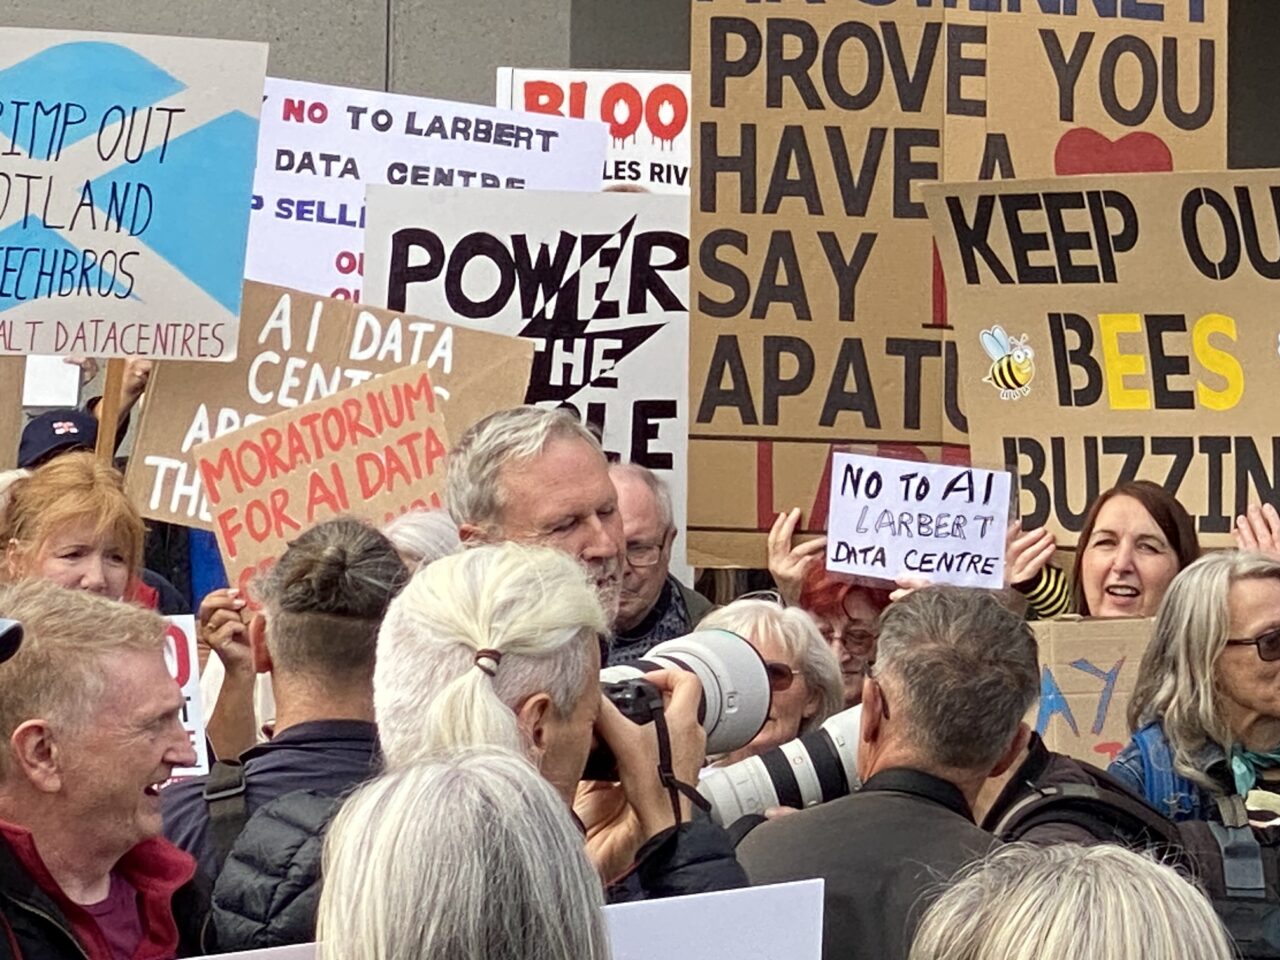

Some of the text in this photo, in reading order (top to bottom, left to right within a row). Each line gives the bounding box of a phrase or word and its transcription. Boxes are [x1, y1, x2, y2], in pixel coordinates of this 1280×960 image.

[709, 15, 1216, 130] PROVE YOU
[0, 101, 186, 163] IMP OUT
[282, 97, 559, 153] NO TO LARBERT
[275, 149, 360, 180] DATA
[650, 162, 688, 186] RIV
[700, 121, 941, 219] HAVE
[945, 190, 1139, 285] KEEP
[0, 247, 140, 300] ECHBROS
[387, 226, 689, 320] POWER
[698, 229, 878, 323] SAY
[55, 319, 226, 358] DATACENTRES
[258, 293, 453, 374] AI DATA
[533, 338, 623, 388] HE
[1047, 313, 1245, 411] BEES
[200, 372, 436, 506] MORATORIUM
[218, 487, 301, 559] FOR
[307, 462, 350, 522] AI
[355, 426, 447, 501] DATA
[841, 463, 994, 506] NO TO AI
[856, 505, 993, 540] LARBERT
[831, 541, 999, 575] DATA CENTRE
